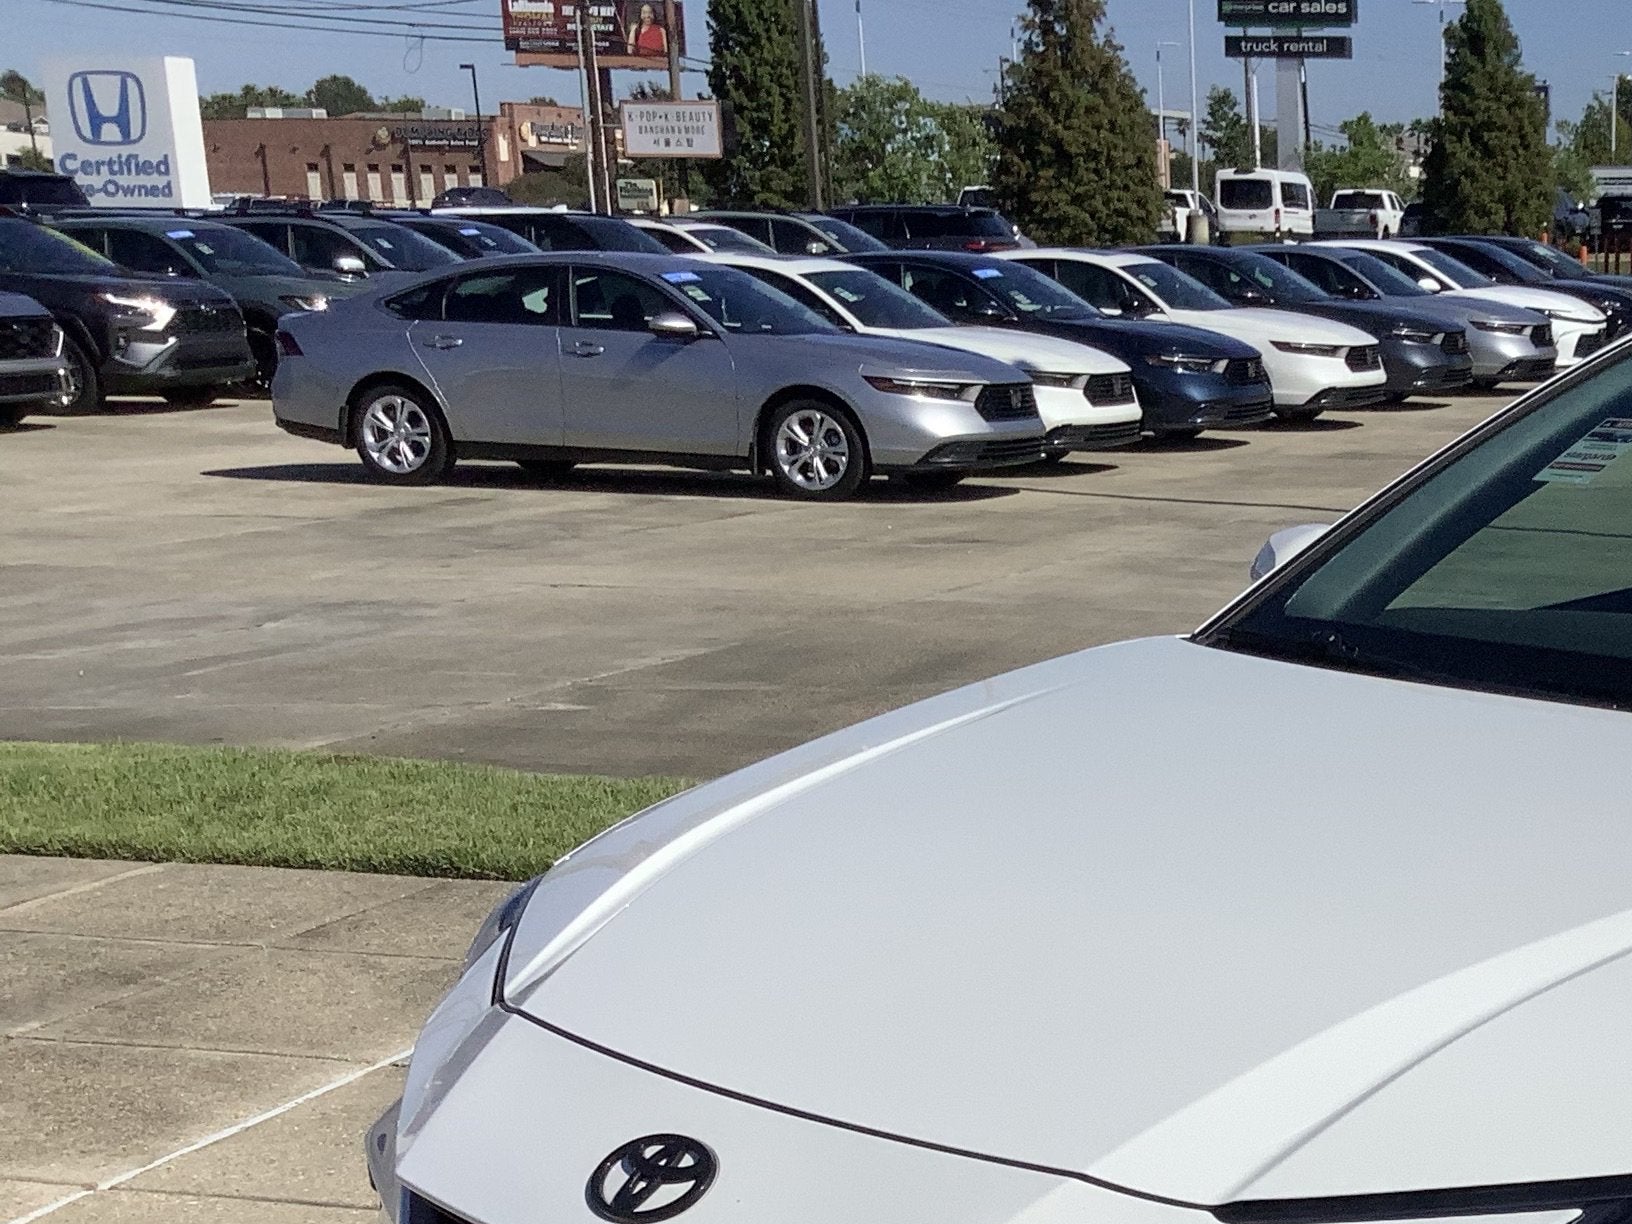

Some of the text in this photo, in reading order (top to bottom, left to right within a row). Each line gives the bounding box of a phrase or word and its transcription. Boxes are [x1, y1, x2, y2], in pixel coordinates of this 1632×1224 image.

[1268, 2, 1297, 13] car
[1301, 0, 1347, 13] sales
[1241, 39, 1327, 52] truck rental
[59, 152, 170, 176] Certified
[80, 179, 173, 198] e-Owned
